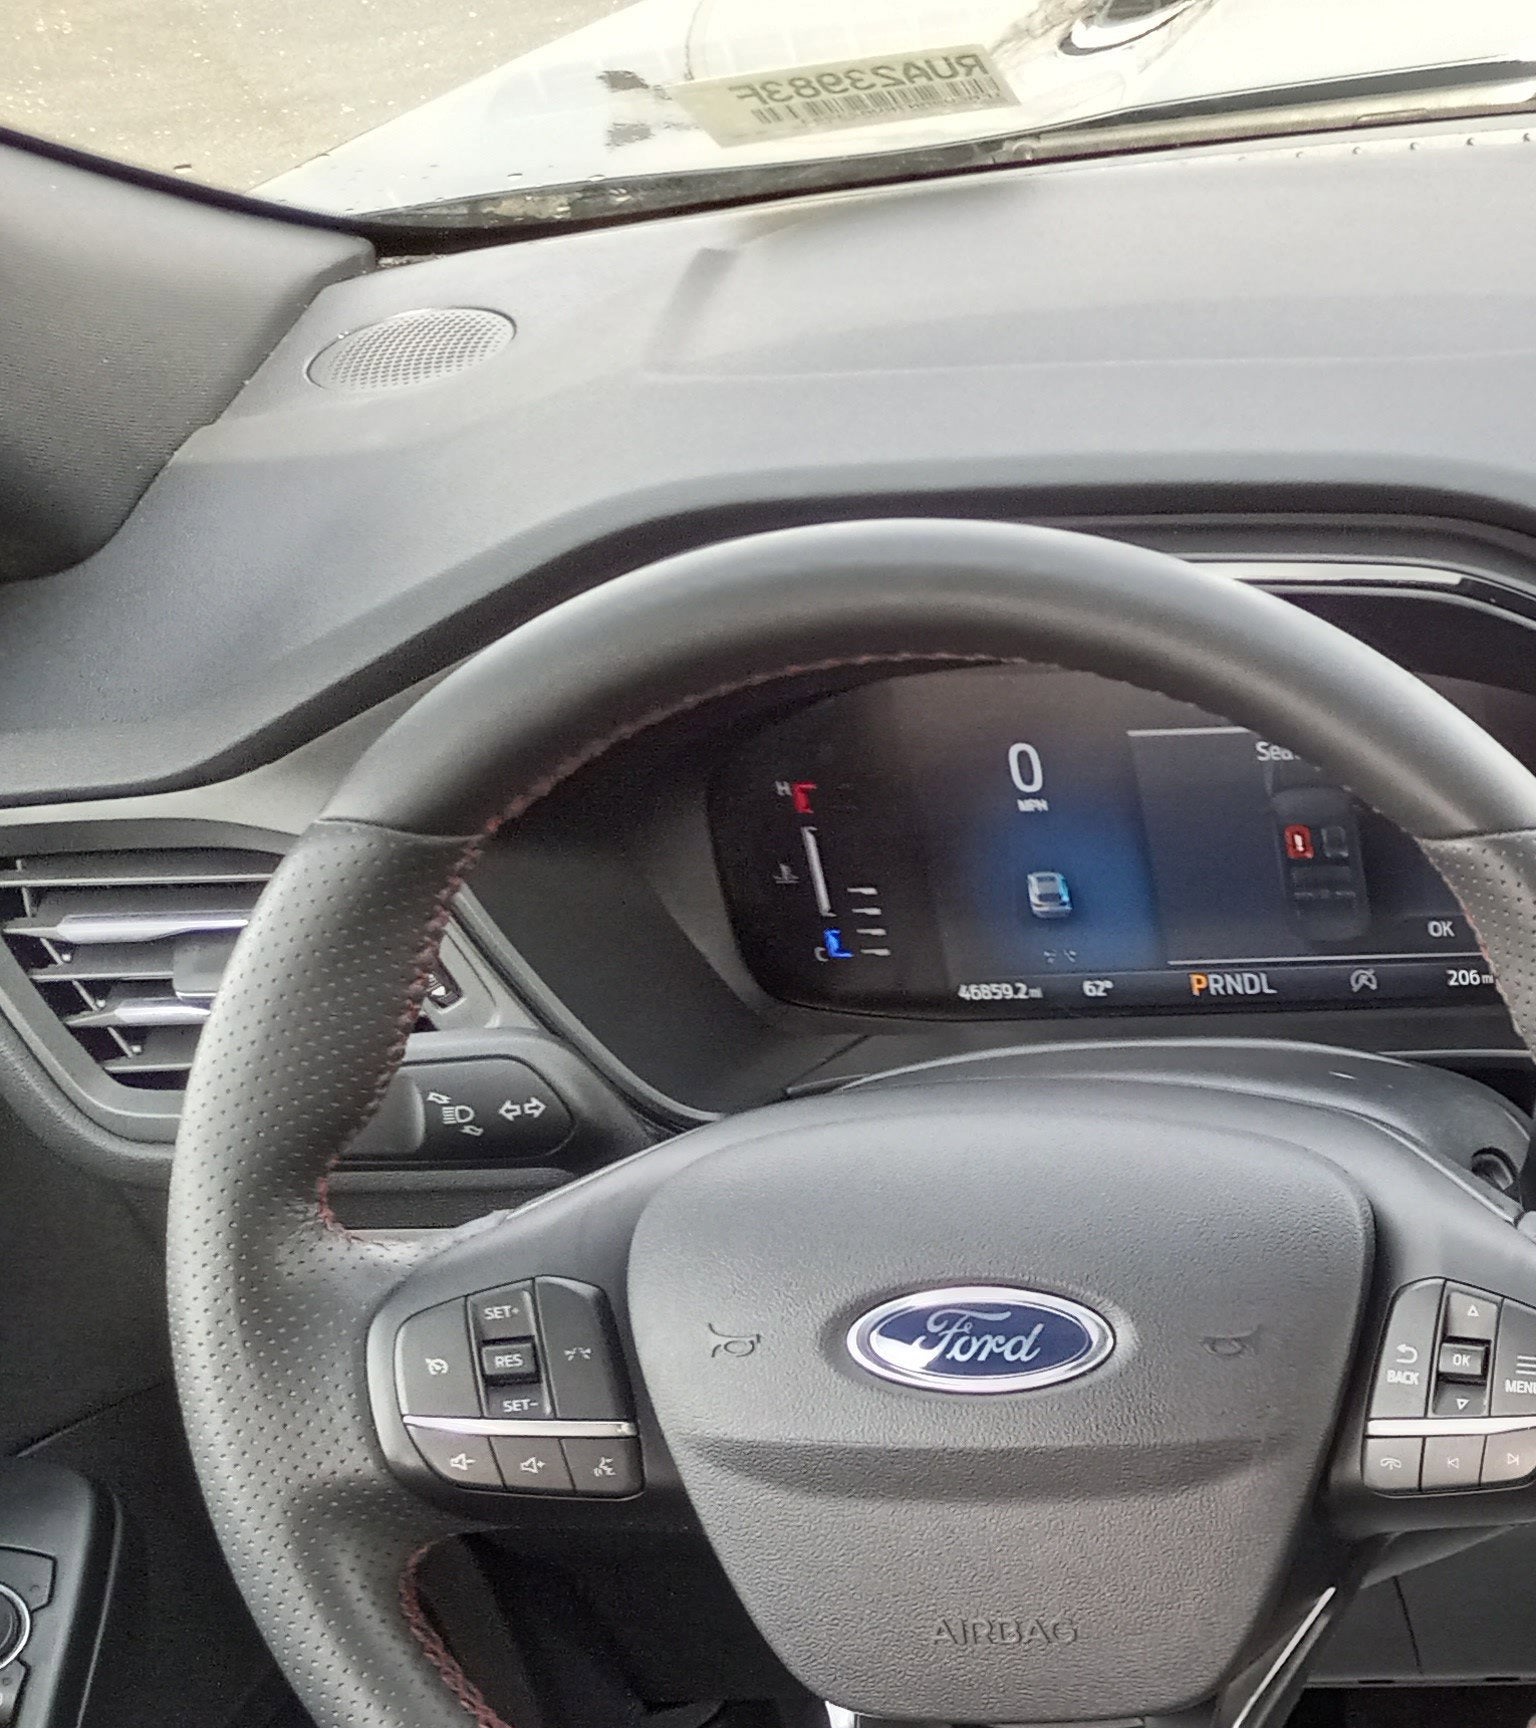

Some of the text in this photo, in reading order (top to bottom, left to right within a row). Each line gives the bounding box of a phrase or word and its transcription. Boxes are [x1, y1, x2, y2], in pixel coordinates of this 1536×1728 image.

[1008, 742, 1044, 793] 0
[1427, 920, 1456, 938] OK
[484, 1305, 520, 1321] SET+
[913, 1308, 1046, 1364] Ford
[494, 1353, 524, 1369] RES
[1452, 1353, 1471, 1368] OK
[1386, 1369, 1420, 1386] BACK
[933, 1617, 1079, 1646] AIRBAG
